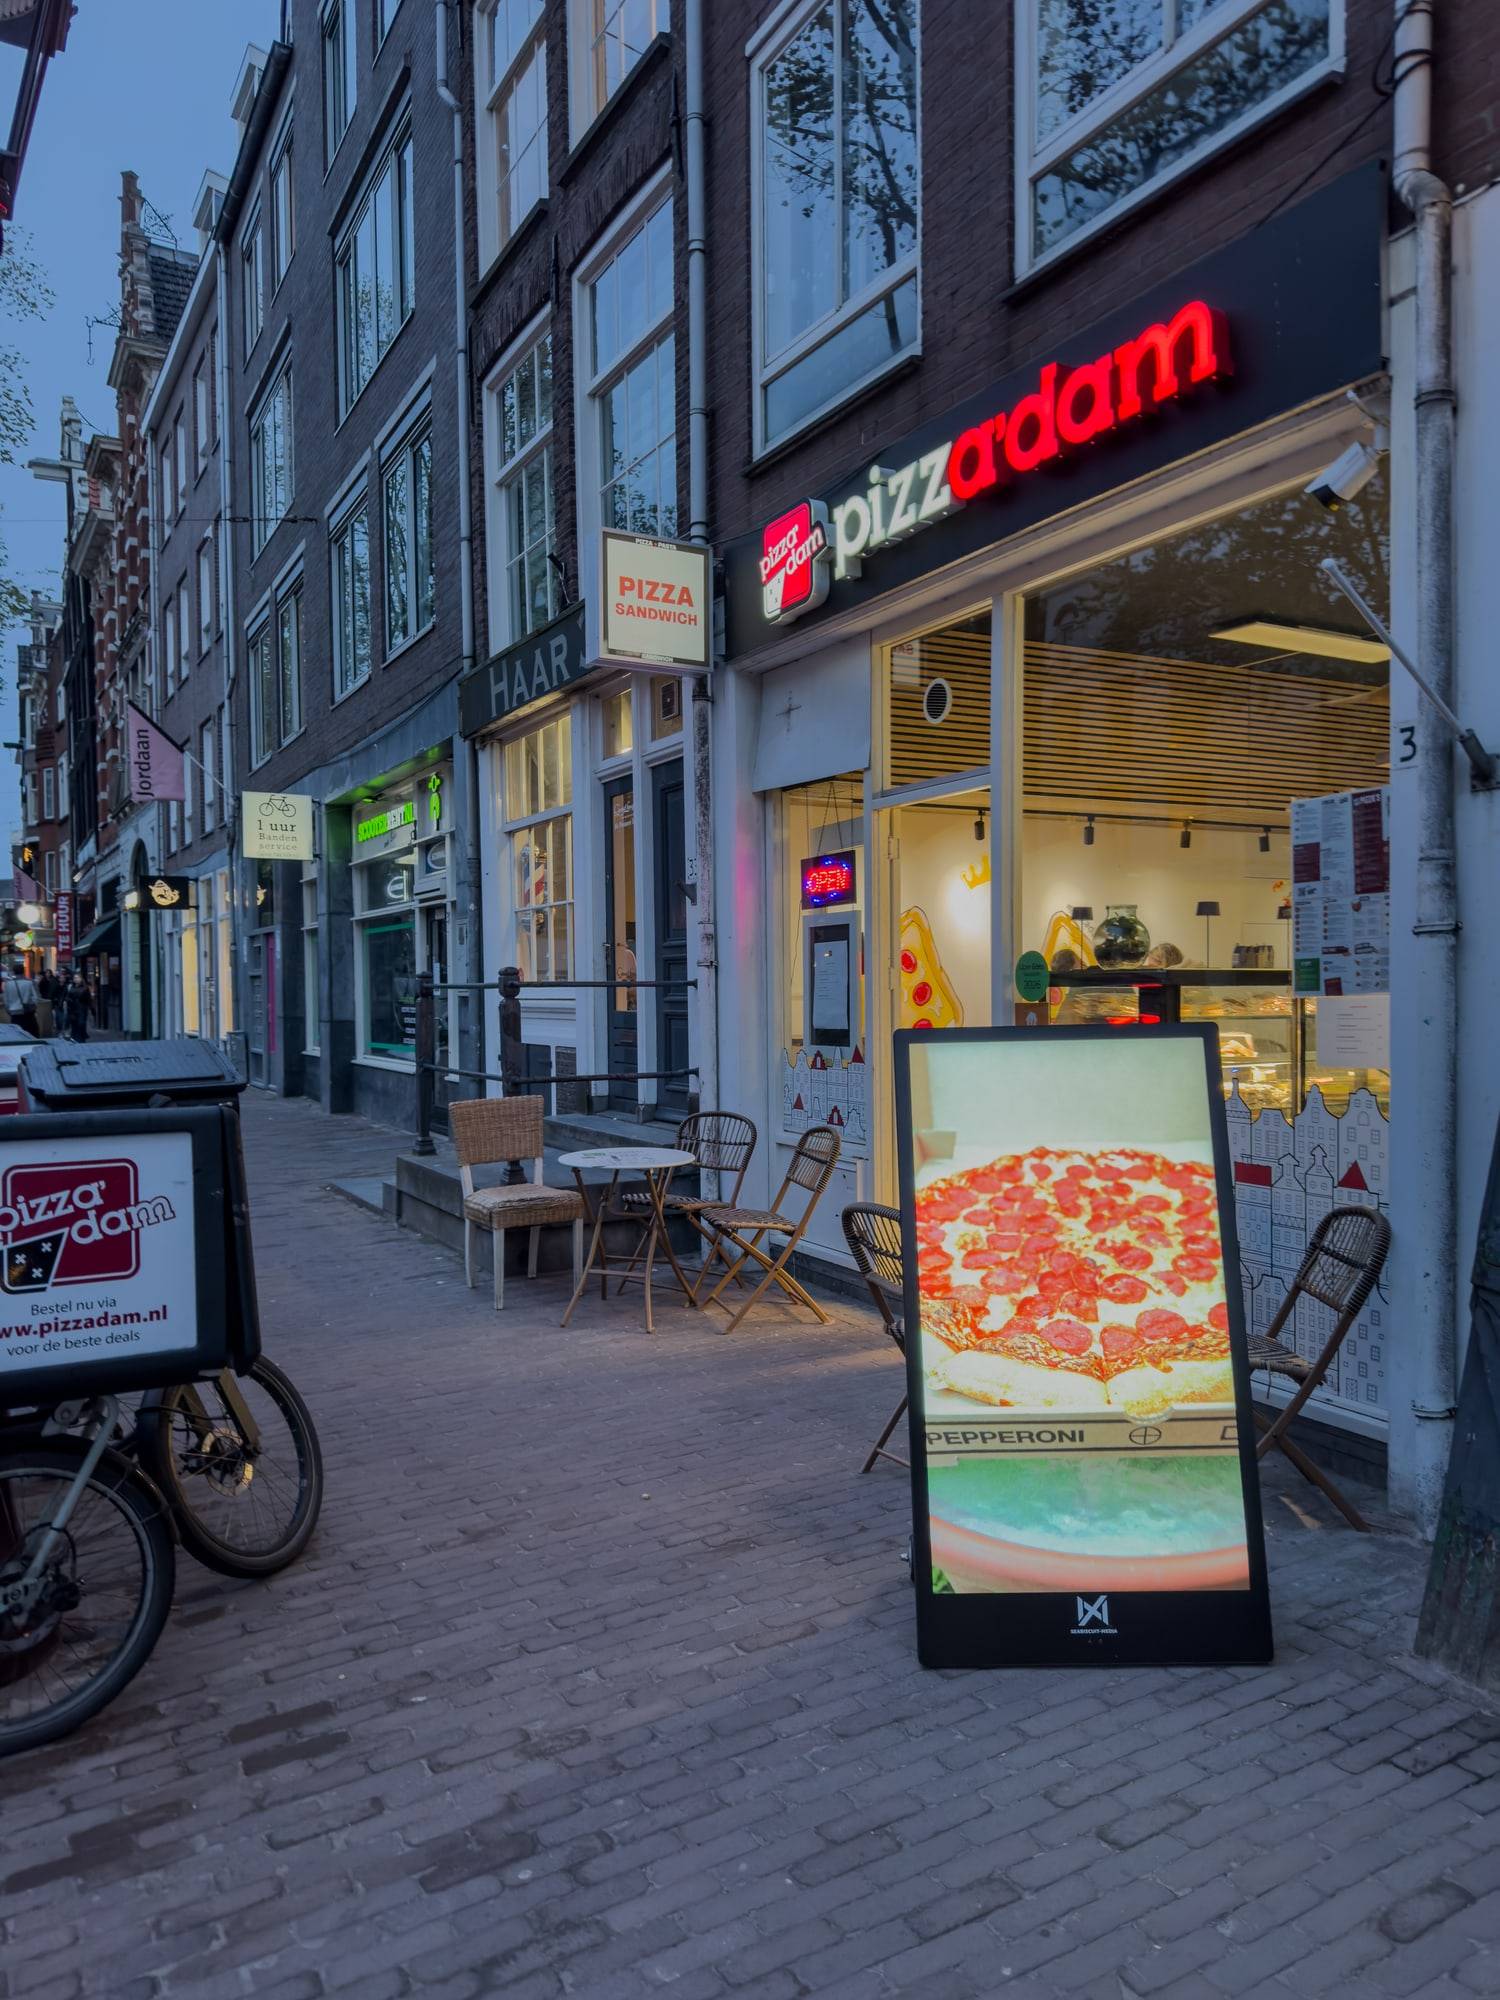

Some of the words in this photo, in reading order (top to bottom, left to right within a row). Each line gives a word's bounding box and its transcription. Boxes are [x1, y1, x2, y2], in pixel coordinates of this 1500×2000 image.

[785, 526, 824, 575] dam
[618, 575, 694, 608] PIZZA
[615, 602, 698, 626] SANDWICH
[489, 633, 571, 718] HAAR
[1400, 725, 1416, 762] 3
[270, 823, 297, 832] uur
[809, 869, 847, 892] OPEN
[58, 896, 71, 931] HUUR
[58, 934, 71, 952] TE
[70, 1195, 176, 1245] dam
[31, 1302, 73, 1315] Bestel
[76, 1300, 94, 1310] nu
[96, 1297, 117, 1308] via
[7, 1344, 41, 1356] voor
[43, 1339, 61, 1352] de
[64, 1336, 102, 1350] beste
[105, 1330, 141, 1345] deals
[926, 1430, 1085, 1445] PEPPERONI
